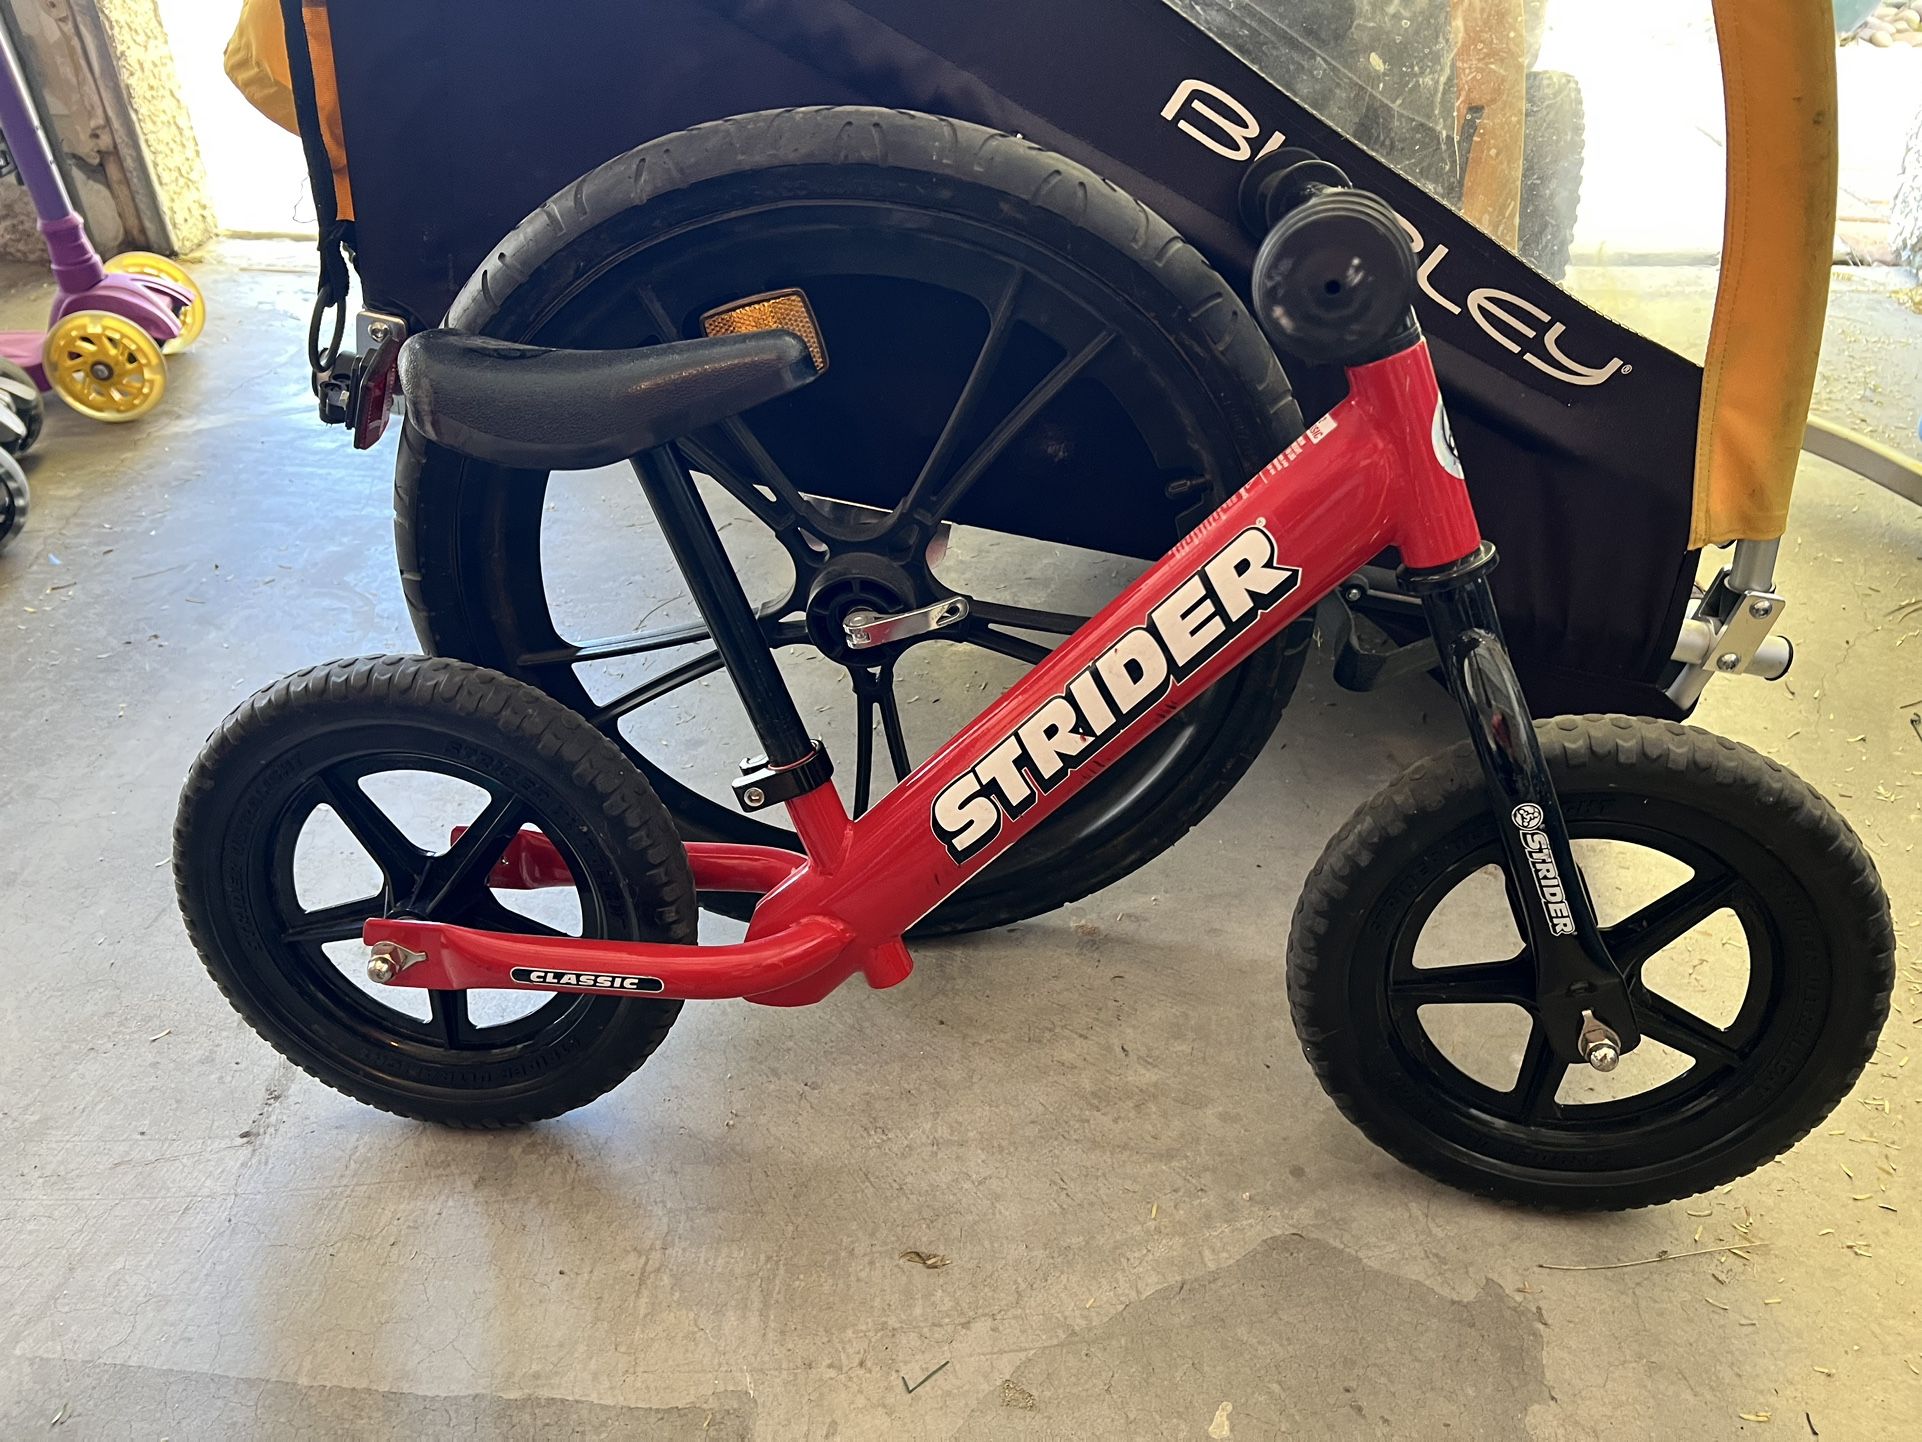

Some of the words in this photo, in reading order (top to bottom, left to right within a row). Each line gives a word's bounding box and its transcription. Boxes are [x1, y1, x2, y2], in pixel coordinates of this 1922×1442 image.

[1160, 79, 1624, 386] BLEY
[933, 526, 1300, 860] STRIDER
[530, 971, 639, 989] CLASSIC
[1519, 830, 1577, 937] STRIDER
